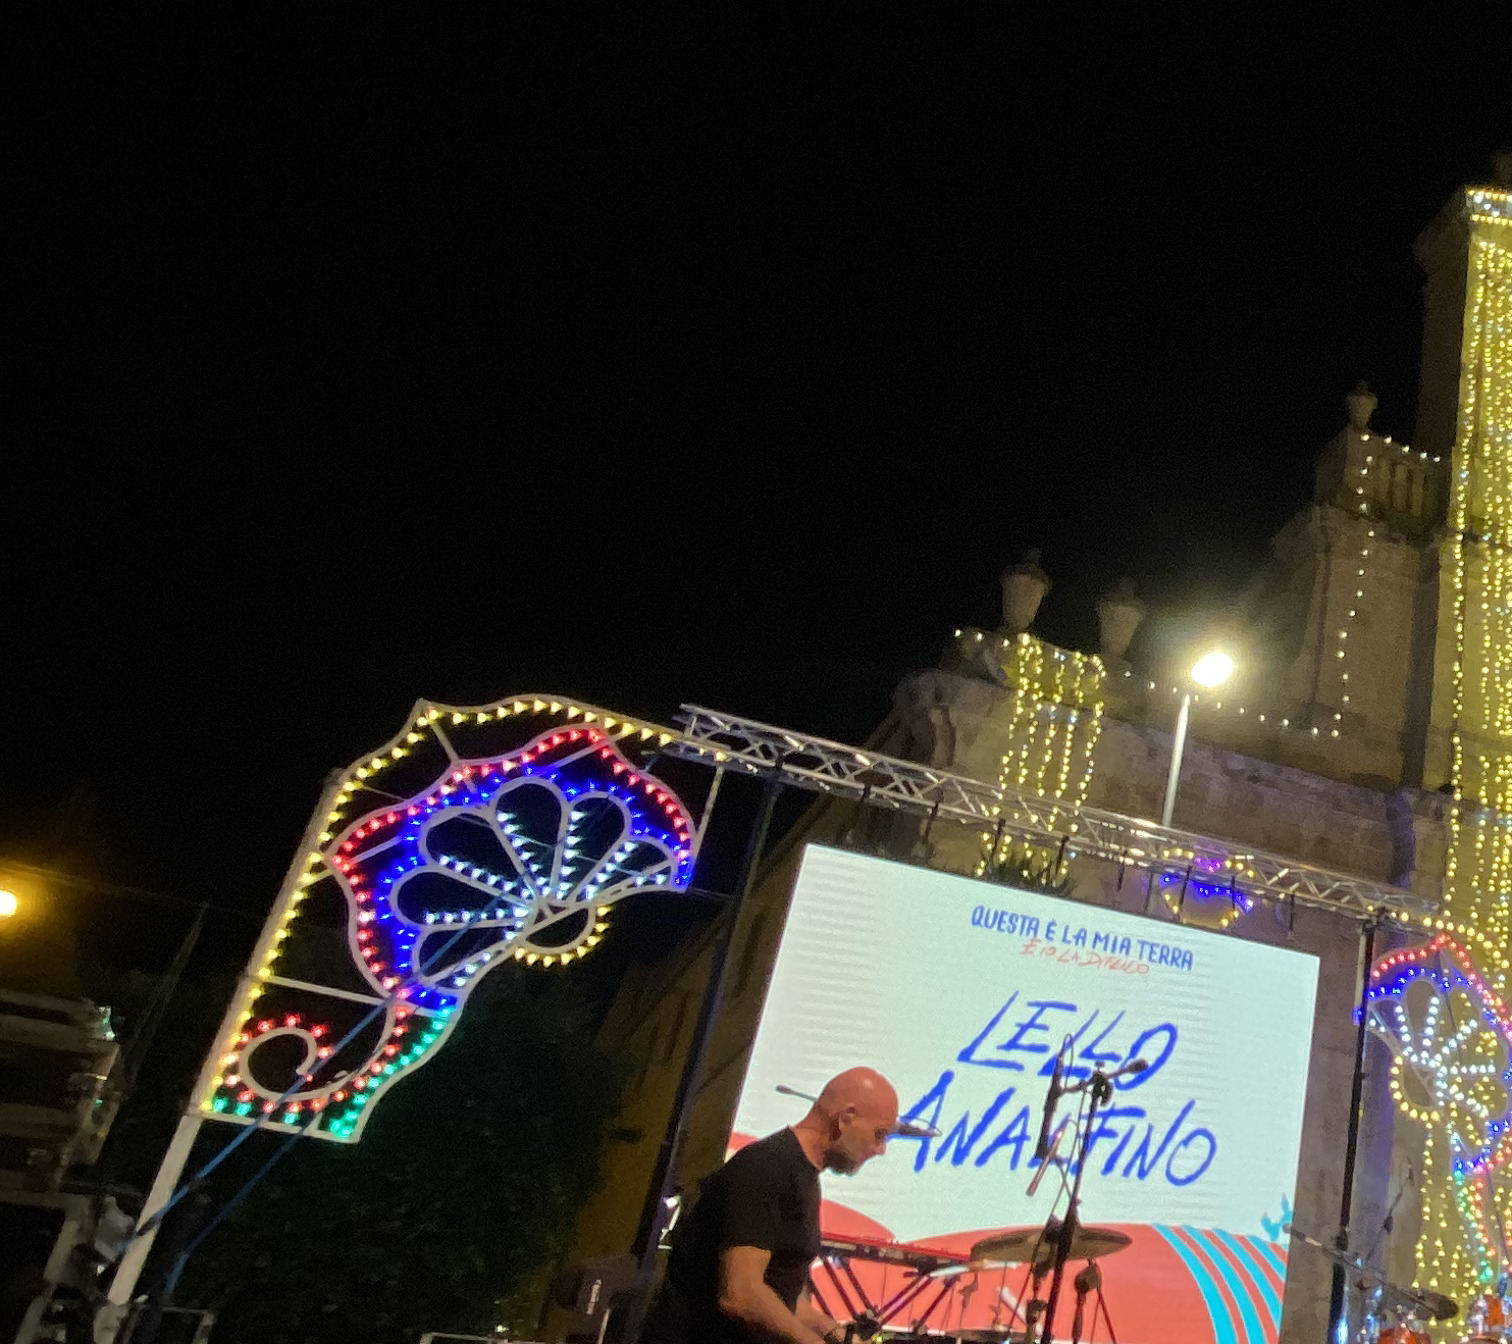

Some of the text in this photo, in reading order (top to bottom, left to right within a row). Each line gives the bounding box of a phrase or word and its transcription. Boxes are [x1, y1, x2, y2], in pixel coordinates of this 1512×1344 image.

[971, 906, 1040, 937] QUESTA
[1062, 925, 1087, 948] LA
[1092, 931, 1131, 956] MIA
[1137, 940, 1193, 971] TERRA
[1057, 948, 1080, 963] LA
[957, 990, 1178, 1091] LELLO
